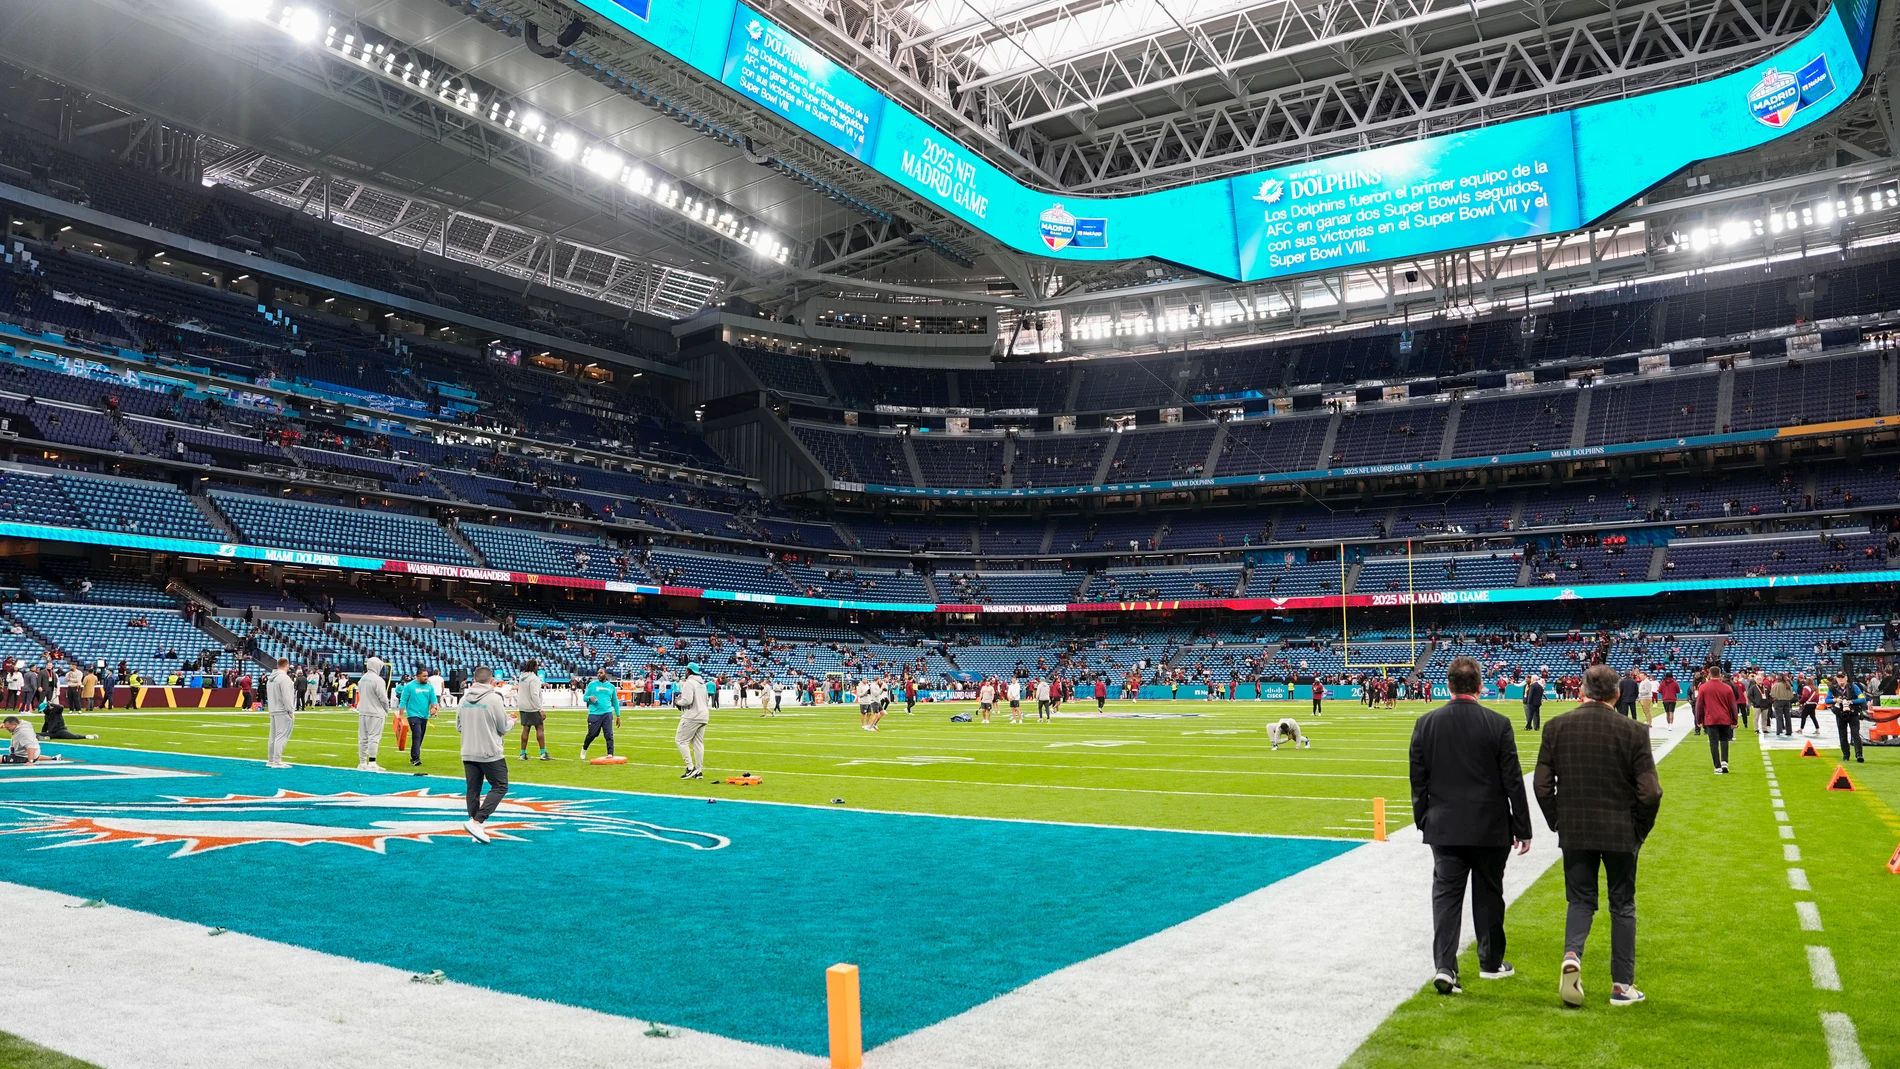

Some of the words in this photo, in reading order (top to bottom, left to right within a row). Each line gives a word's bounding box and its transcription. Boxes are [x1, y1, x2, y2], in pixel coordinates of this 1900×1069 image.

[740, 76, 760, 94] Super
[761, 88, 777, 104] Bowl
[744, 54, 759, 68] AFC
[760, 65, 768, 74] en
[770, 70, 788, 86] ganar
[789, 80, 800, 93] dos
[802, 88, 820, 105] Super
[820, 101, 838, 118] Bowls
[839, 111, 864, 133] seguidos,
[746, 41, 758, 56] Los
[760, 50, 787, 73] Dolphins
[789, 67, 808, 86] fueron
[816, 86, 835, 102] primer
[836, 96, 854, 114] equipo
[856, 108, 862, 119] de
[864, 114, 869, 124] la
[1808, 73, 1826, 88] NetApp
[742, 66, 754, 78] con
[756, 74, 768, 87] sus
[769, 81, 795, 102] victorias
[796, 98, 804, 108] en
[805, 102, 810, 112] el
[812, 106, 830, 122] Super
[830, 118, 844, 132] Bowl
[858, 134, 864, 144] el
[1754, 87, 1796, 112] MADRID
[921, 138, 955, 174] 2025
[954, 157, 976, 189] NFL
[1289, 168, 1320, 179] MIAMI
[901, 150, 952, 198] MADRID
[952, 182, 988, 220] GAME
[1264, 208, 1287, 222] Los
[1290, 200, 1346, 218] Dolphins
[1349, 189, 1391, 207] fueron
[1395, 184, 1408, 199] el
[1411, 178, 1455, 199] primer
[1460, 169, 1508, 188] equipo
[1512, 164, 1530, 178] de
[1534, 160, 1548, 174] la
[1290, 170, 1381, 200] DOLPHINS
[1266, 222, 1293, 238] AFC
[1297, 220, 1312, 232] en
[1316, 213, 1352, 232] ganar
[1356, 208, 1380, 222] dos
[1384, 200, 1424, 216] Super
[1428, 191, 1470, 209] Bowls
[1474, 180, 1543, 202] seguidos,
[1268, 240, 1291, 252] con
[1295, 235, 1316, 248] sus
[1320, 226, 1374, 242] victorias
[1378, 222, 1394, 233] en
[1398, 216, 1410, 230] el
[1414, 212, 1455, 231] Super
[1459, 202, 1495, 220] Bowl
[1498, 198, 1517, 214] VII
[1522, 198, 1530, 212] y
[1535, 192, 1548, 207] el
[1041, 222, 1072, 234] MADRID
[1270, 252, 1306, 268] Super
[1310, 244, 1342, 261] Bowl
[1346, 240, 1370, 254] VIII.
[1551, 450, 1571, 458] MIAMI
[1573, 447, 1604, 456] DOLPHINS
[1370, 465, 1394, 474] MADRID
[265, 550, 294, 562] MIAMI
[296, 552, 338, 566] DOLPHINS
[407, 563, 458, 576] WASHINGTON
[460, 568, 510, 581] COMMANDERS
[1024, 604, 1067, 612] COMMANDERS
[1373, 595, 1397, 606] 2025
[1398, 594, 1417, 604] NFL
[1418, 592, 1458, 604] MADRID
[1460, 590, 1489, 601] GAME
